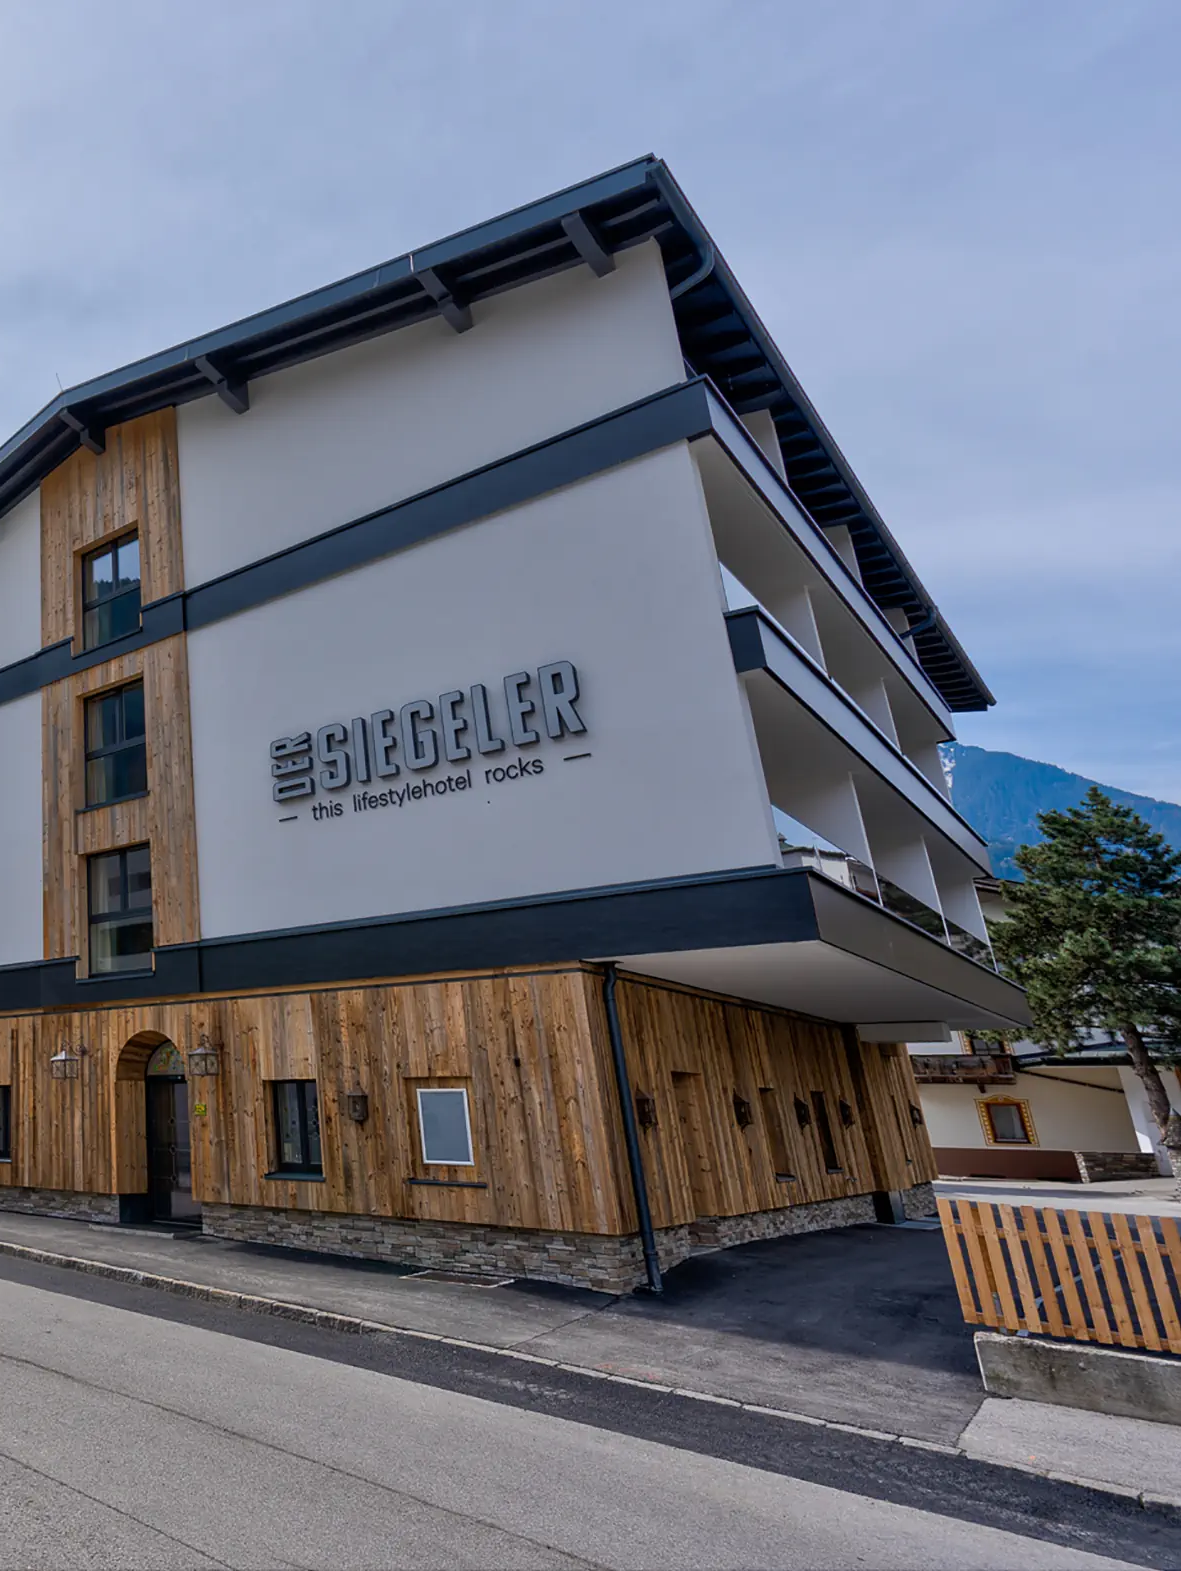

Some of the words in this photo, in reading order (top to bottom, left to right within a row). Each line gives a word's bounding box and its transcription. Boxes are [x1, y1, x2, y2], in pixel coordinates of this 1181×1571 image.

[317, 660, 587, 791] SIEGELER
[270, 731, 315, 802] DER
[312, 800, 344, 821] this
[353, 769, 472, 813] lifestylehotel
[484, 757, 544, 785] rocks
